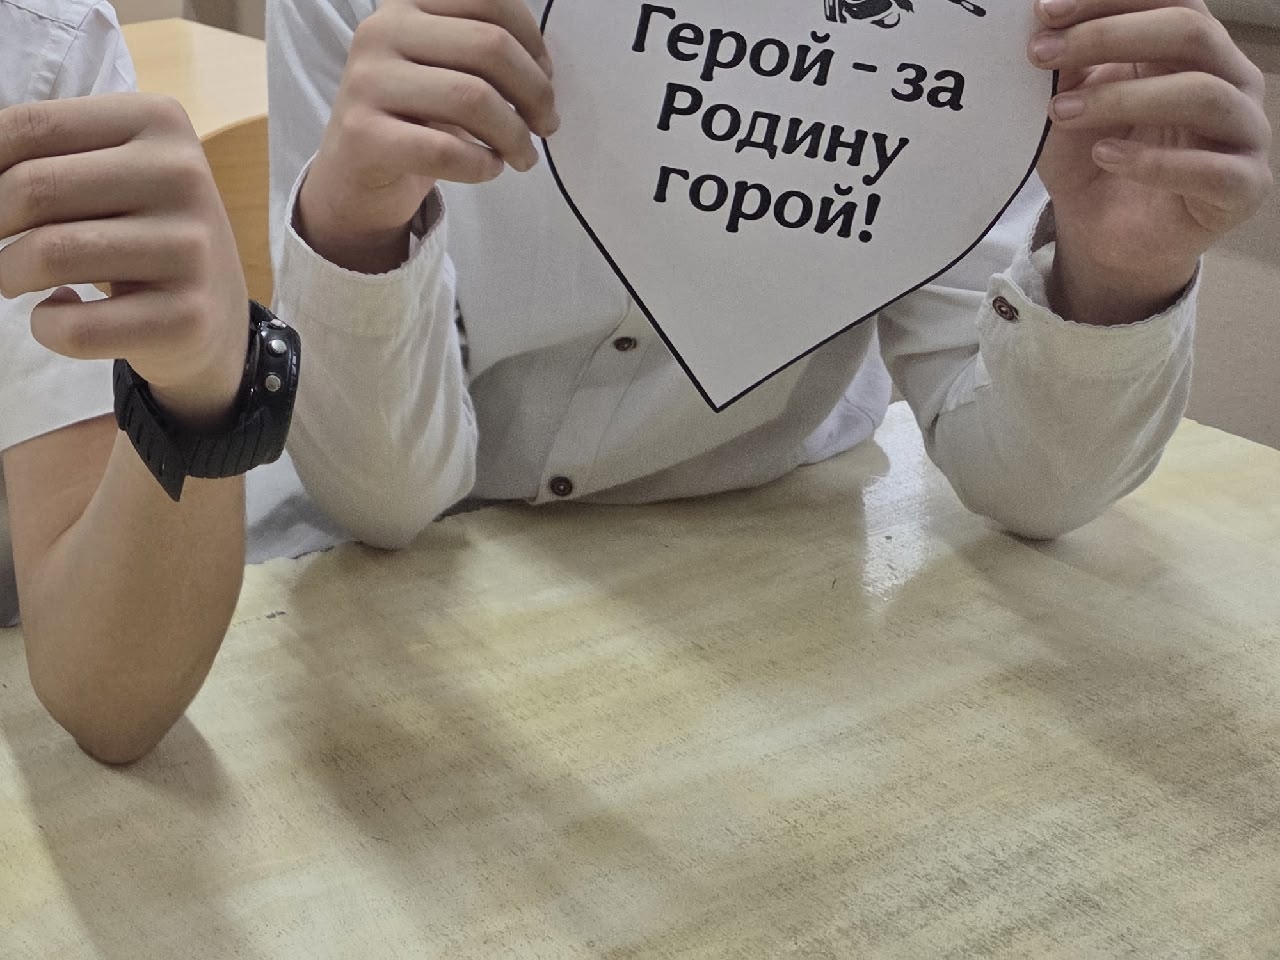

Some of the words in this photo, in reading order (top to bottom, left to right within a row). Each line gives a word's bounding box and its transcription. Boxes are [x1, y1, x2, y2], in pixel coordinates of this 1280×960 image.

[632, 3, 835, 86] Герой
[891, 62, 966, 111] за
[657, 82, 910, 187] Родину
[653, 165, 881, 243] горой!
